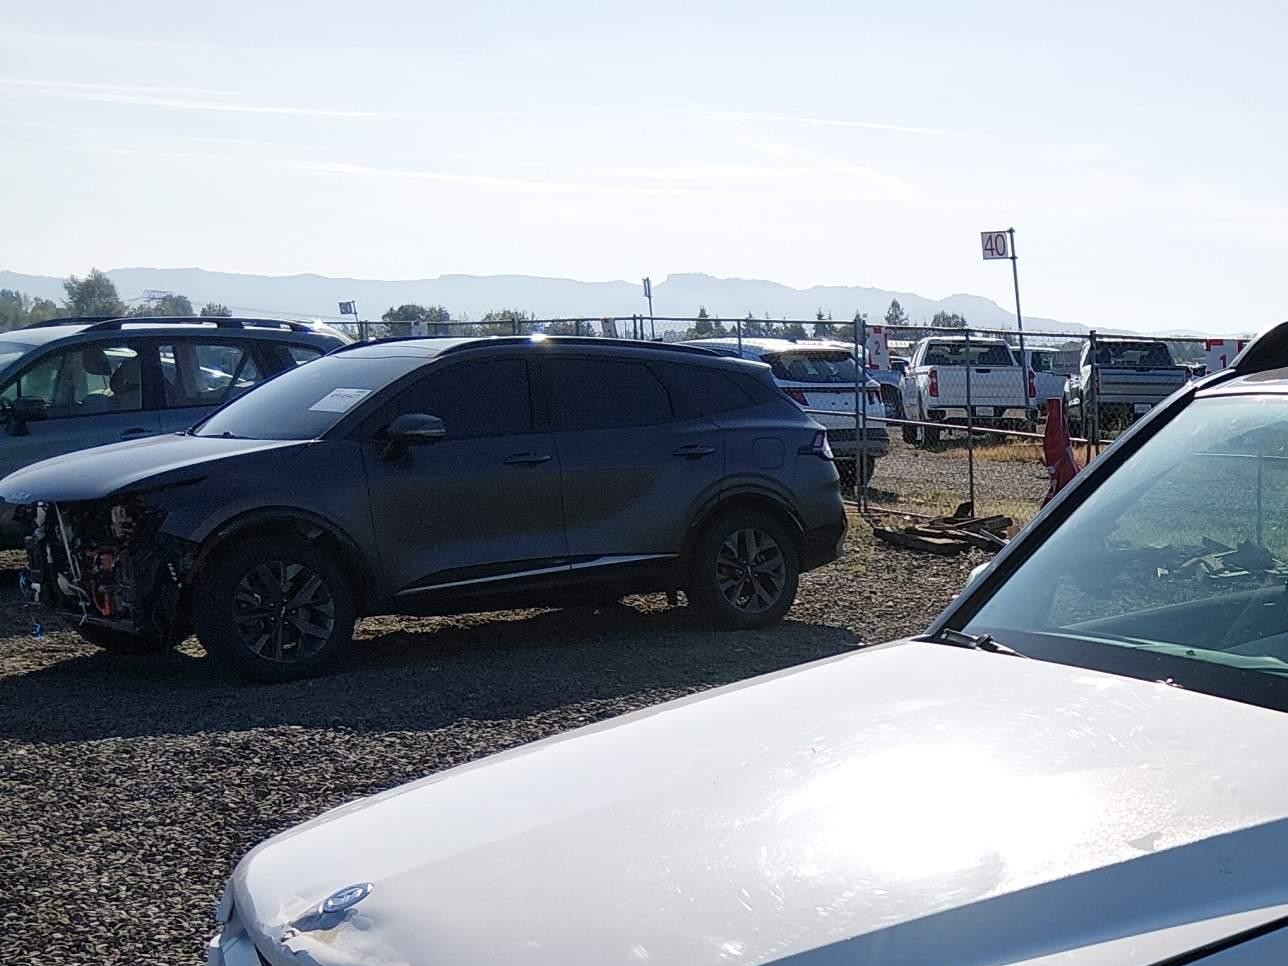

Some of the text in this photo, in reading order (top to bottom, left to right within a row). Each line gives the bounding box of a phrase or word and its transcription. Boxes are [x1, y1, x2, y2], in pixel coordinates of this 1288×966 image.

[984, 234, 1006, 257] 40
[874, 340, 881, 356] 2
[1219, 354, 1227, 369] 1
